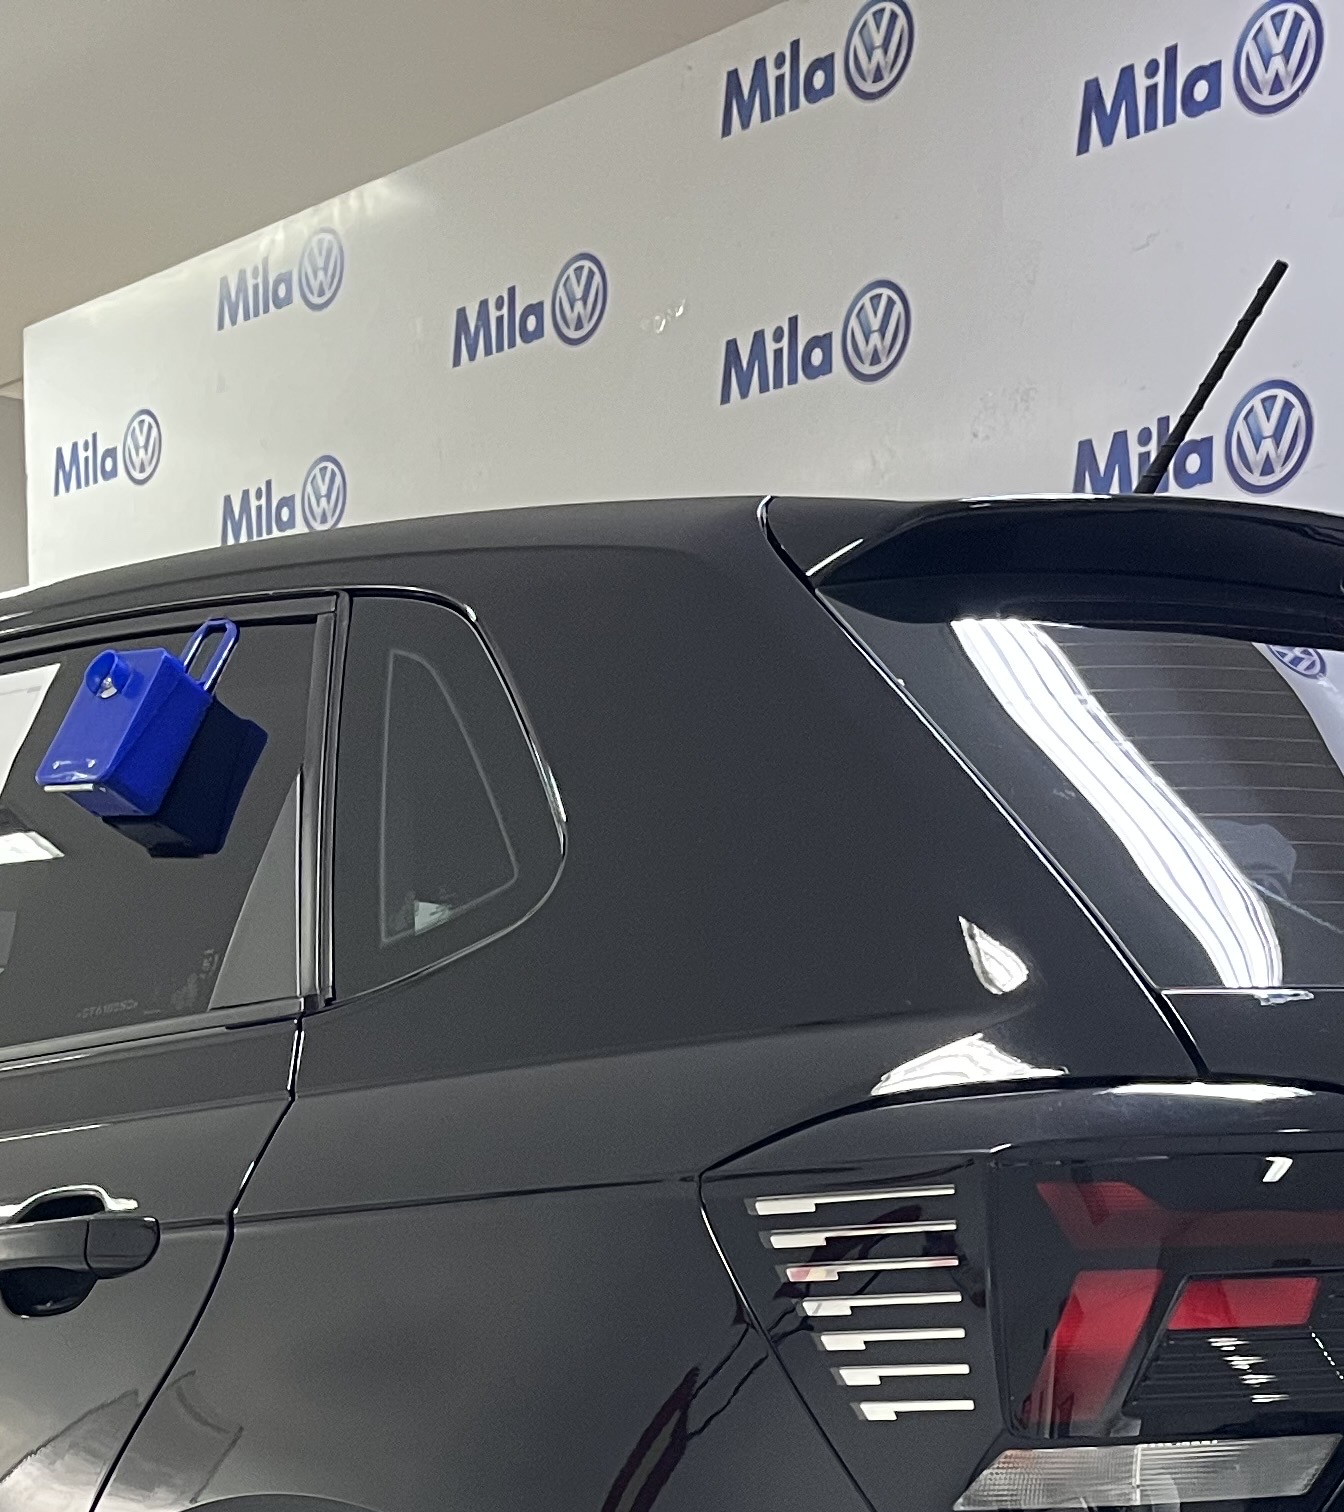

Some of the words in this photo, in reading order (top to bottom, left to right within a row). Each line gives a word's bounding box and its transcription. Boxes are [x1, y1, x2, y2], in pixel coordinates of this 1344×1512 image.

[721, 38, 834, 138] Mila
[1076, 43, 1222, 156] Mila
[218, 266, 293, 331] Mila
[453, 285, 544, 368] Mila
[720, 315, 832, 405] Mila
[54, 432, 117, 496] Mila
[221, 479, 295, 546] Mila
